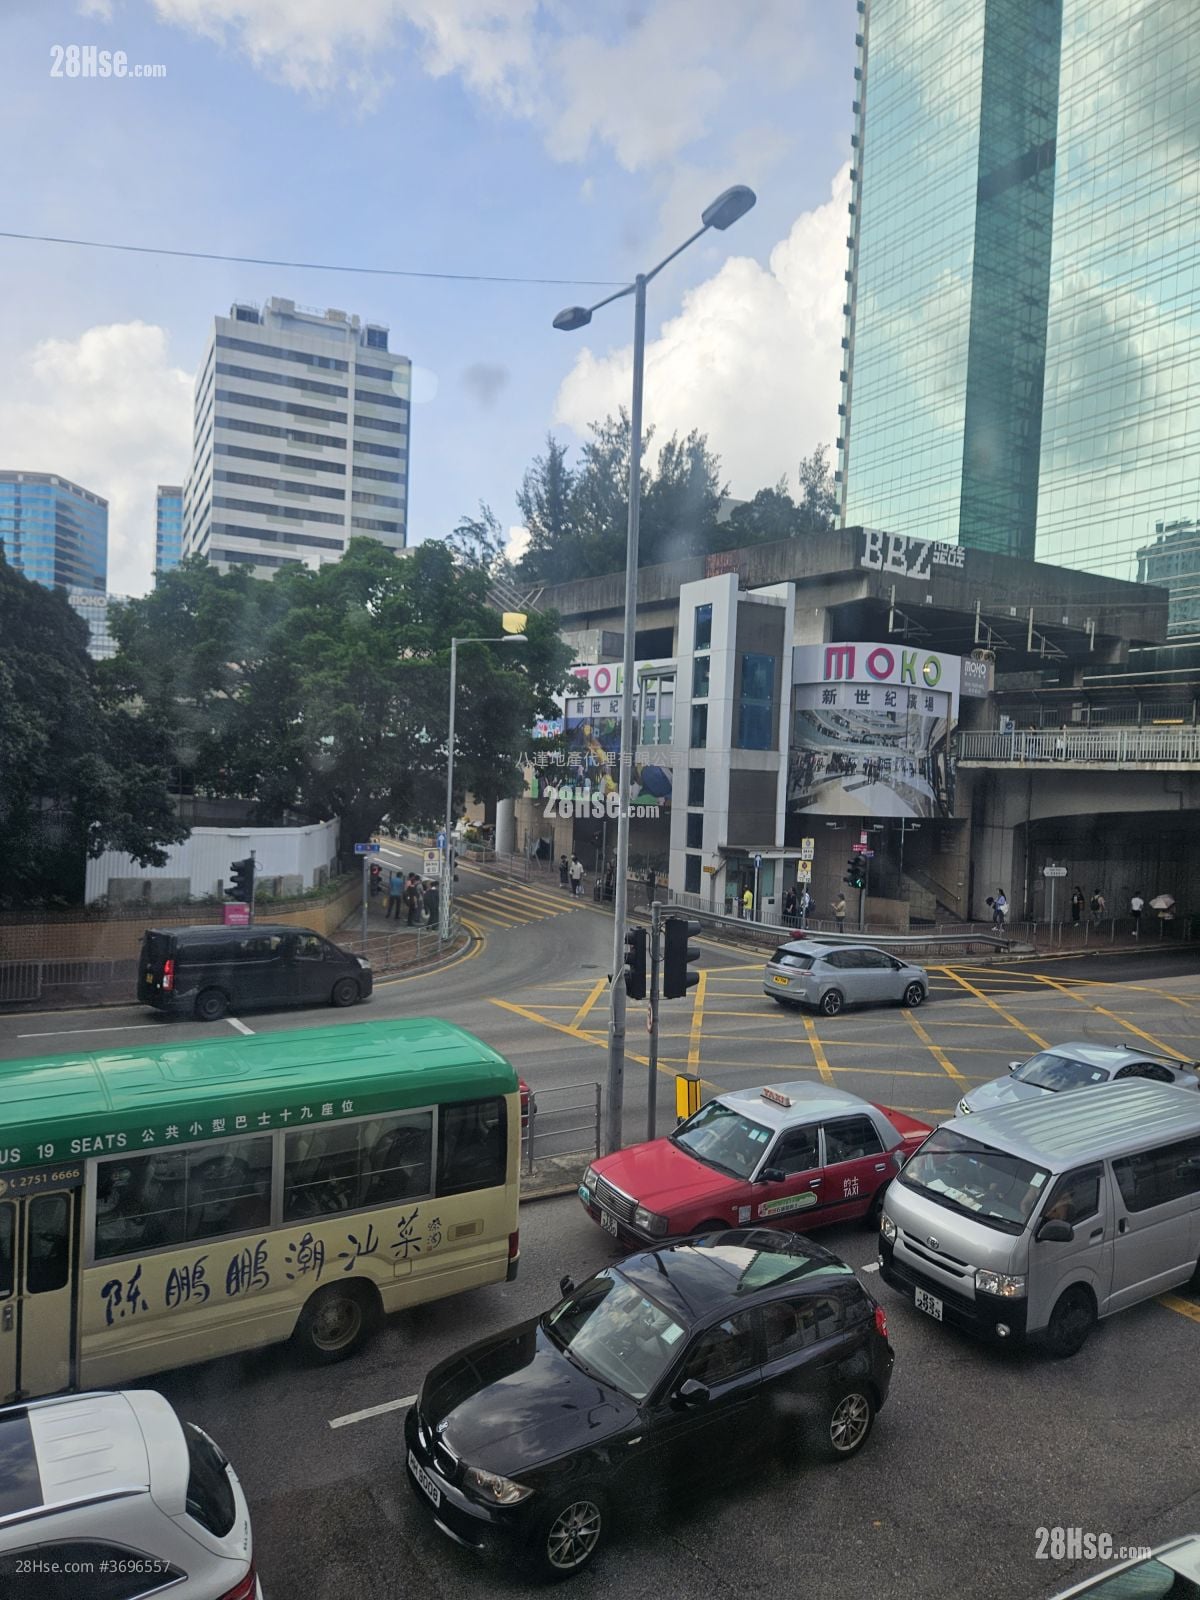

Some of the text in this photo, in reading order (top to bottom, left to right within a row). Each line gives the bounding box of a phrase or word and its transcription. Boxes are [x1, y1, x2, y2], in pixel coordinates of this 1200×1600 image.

[861, 527, 933, 580] BBZ
[68, 595, 107, 607] MOKO
[823, 646, 942, 687] MOKO
[822, 688, 934, 712] 新世紀廣場
[763, 1087, 785, 1104] TAXI
[142, 1099, 354, 1143] 公共小型巴士十九座位
[37, 1144, 54, 1159] 19
[70, 1133, 127, 1154] SEATS
[19, 1169, 81, 1187] 2751 6666
[844, 1176, 859, 1188] 的士
[844, 1186, 859, 1198] TAXI
